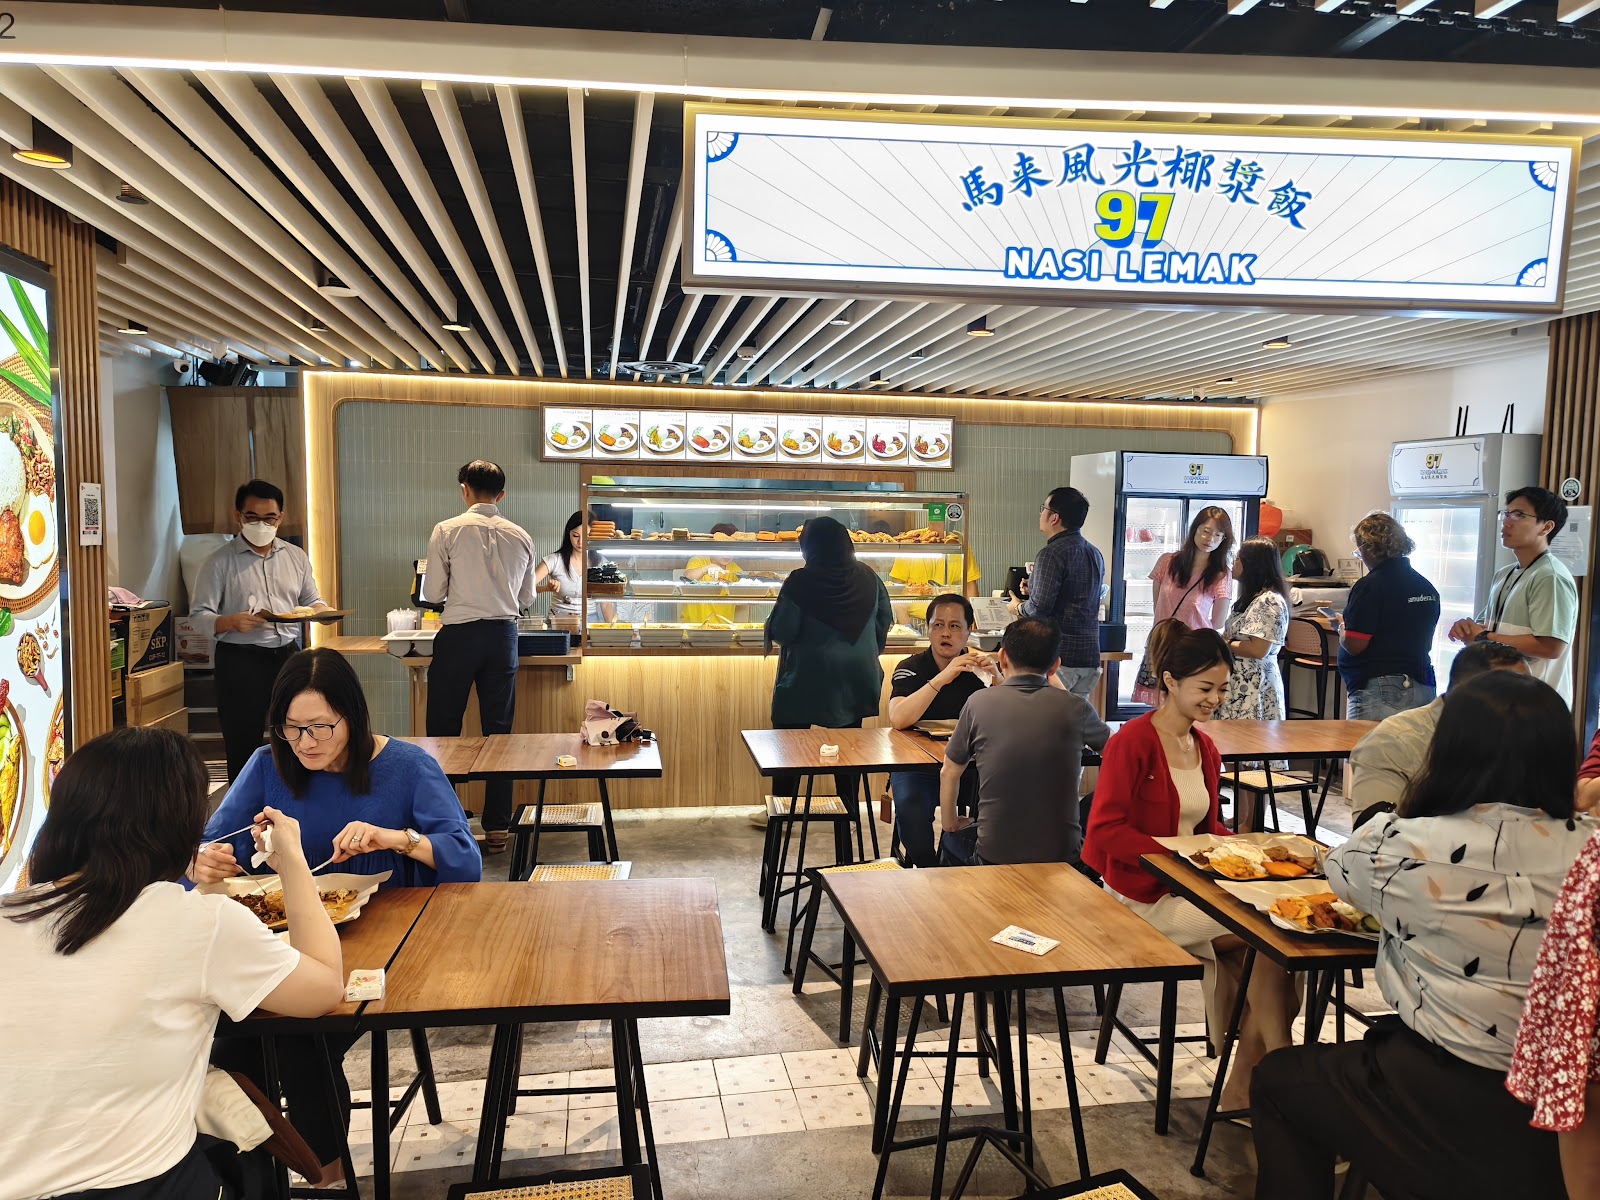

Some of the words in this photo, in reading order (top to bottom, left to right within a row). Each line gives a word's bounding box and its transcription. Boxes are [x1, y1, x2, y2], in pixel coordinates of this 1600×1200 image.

[1094, 190, 1176, 249] 97
[1004, 247, 1102, 281] NASI
[1115, 251, 1258, 286] LEMAK
[1425, 453, 1443, 469] 97
[1188, 463, 1204, 476] 97
[151, 636, 166, 649] SKP
